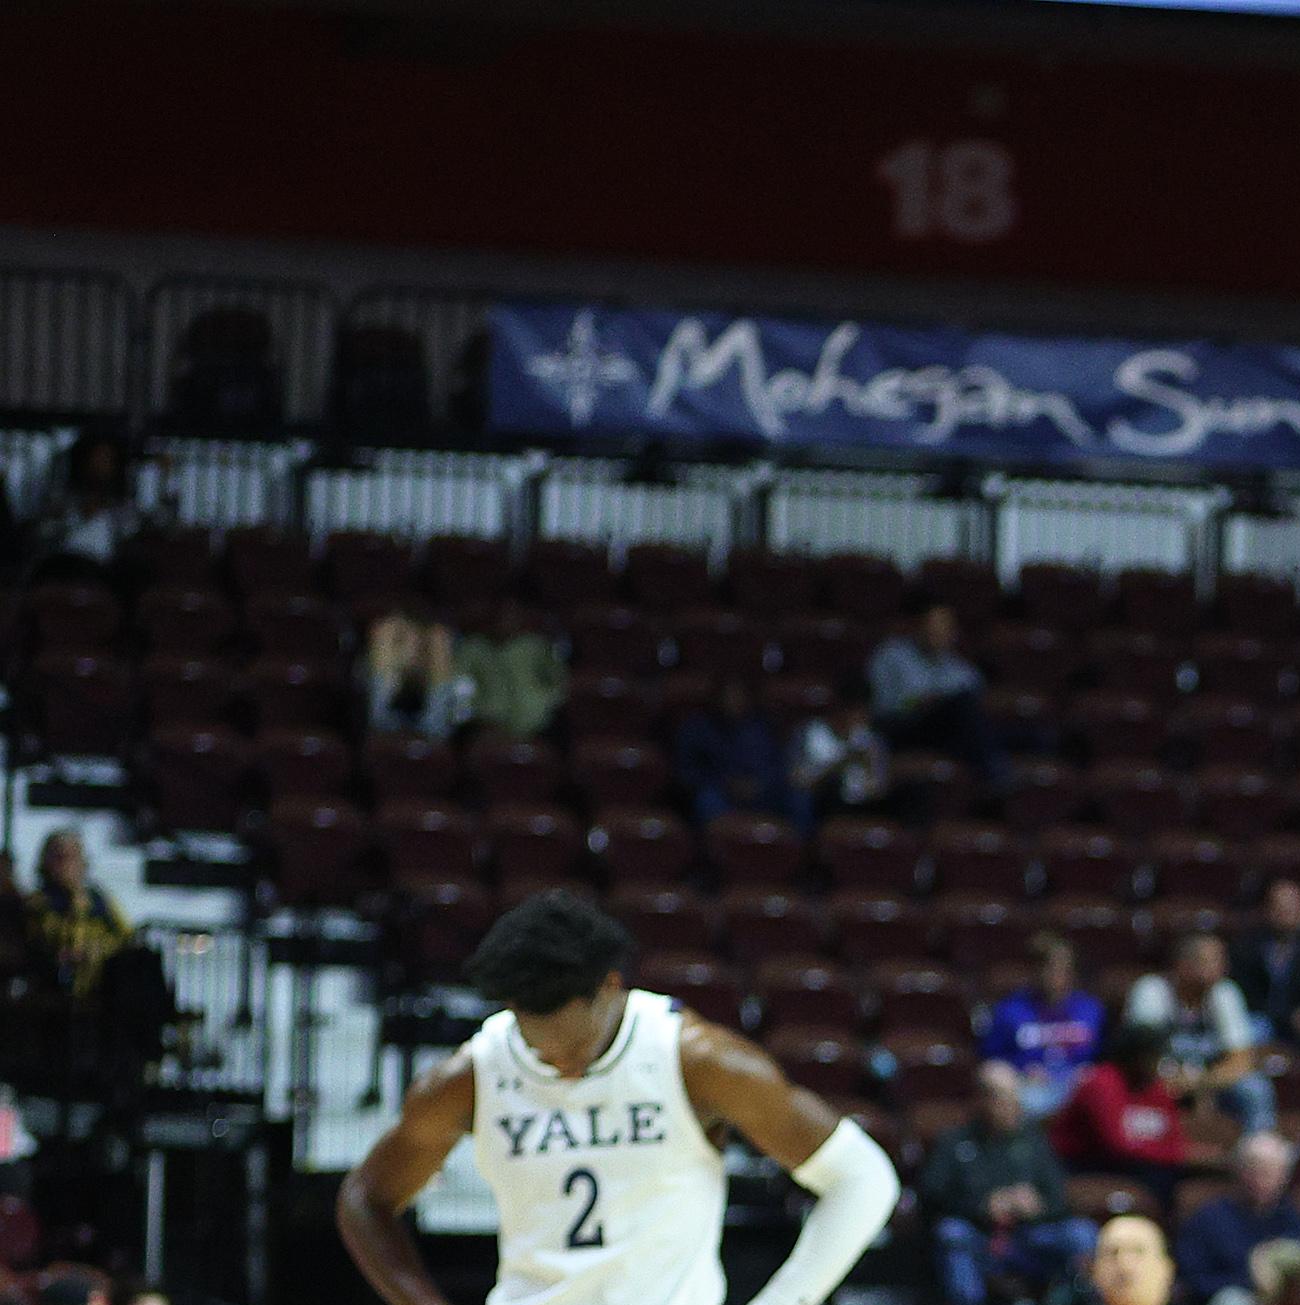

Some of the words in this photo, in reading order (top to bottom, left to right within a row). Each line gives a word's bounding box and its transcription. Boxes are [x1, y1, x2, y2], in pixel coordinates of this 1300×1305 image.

[878, 141, 1015, 240] 18
[647, 318, 1095, 448] Mohegan
[498, 1103, 666, 1156] YALE
[563, 1167, 604, 1249] 2
